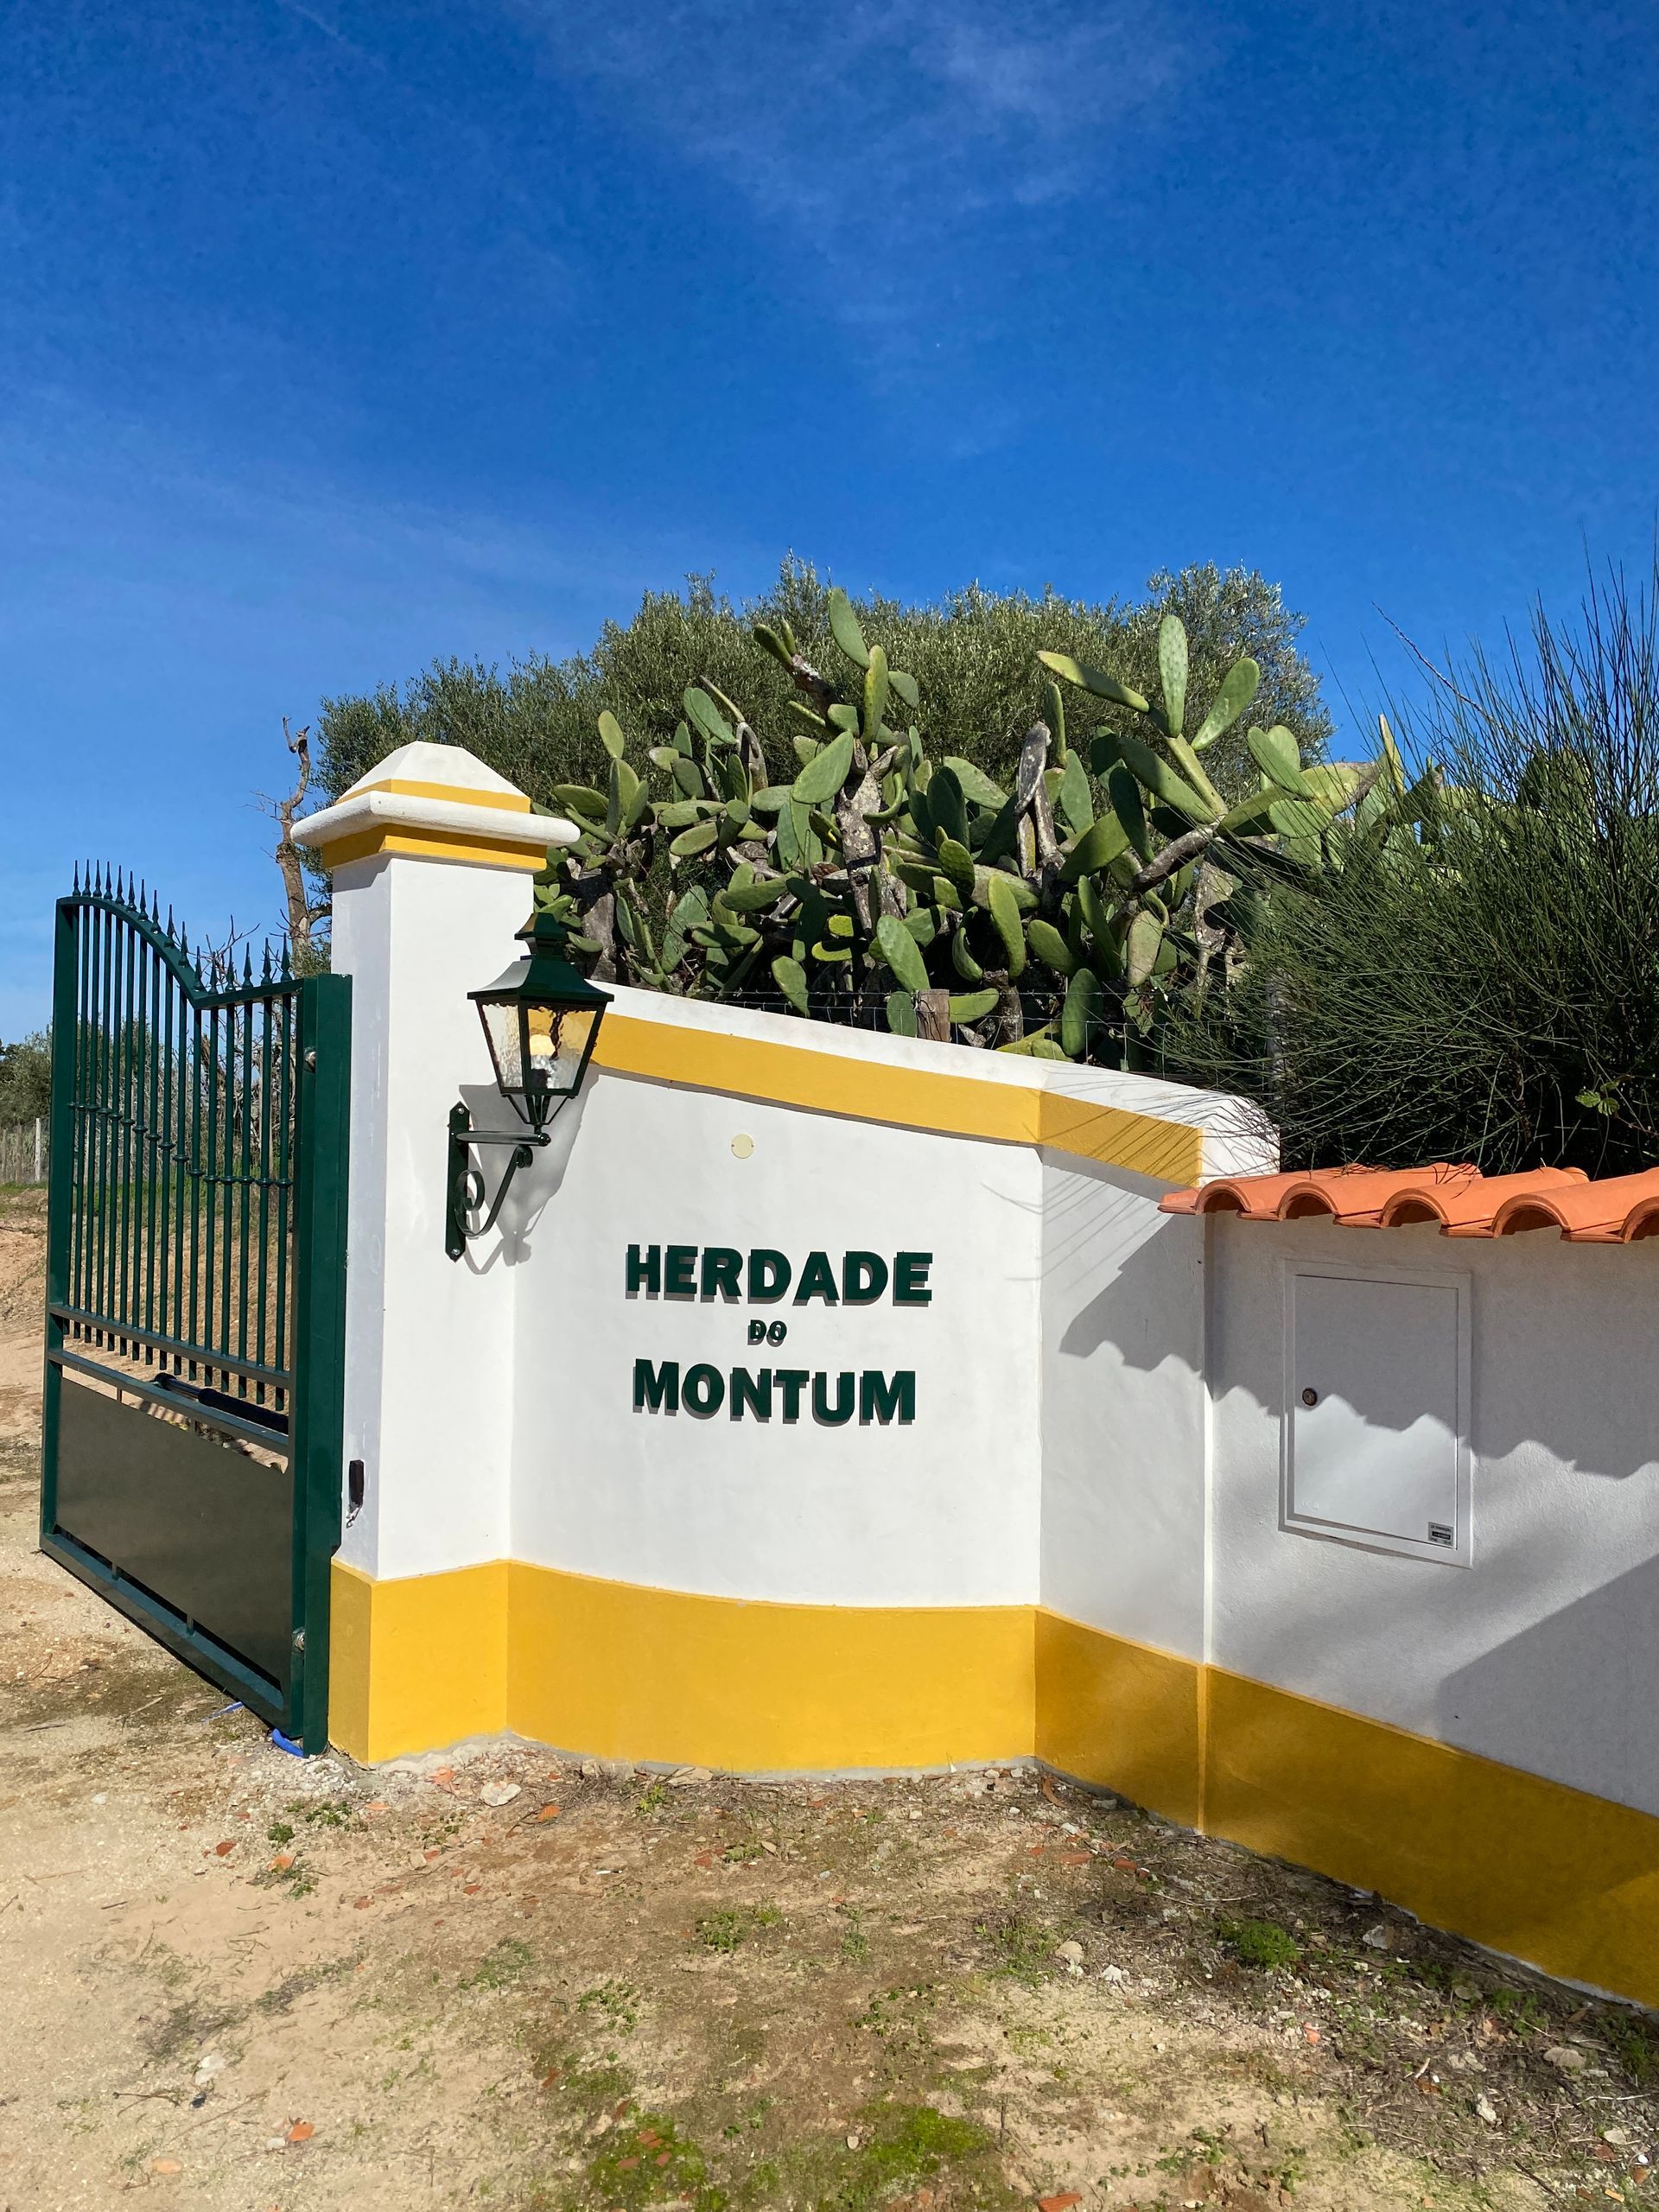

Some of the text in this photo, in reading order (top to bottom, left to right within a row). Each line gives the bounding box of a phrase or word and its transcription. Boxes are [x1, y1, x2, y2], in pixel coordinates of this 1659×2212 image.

[627, 1244, 933, 1301] HERDADE
[750, 1319, 787, 1341] DO
[635, 1358, 916, 1422] MONTUM
